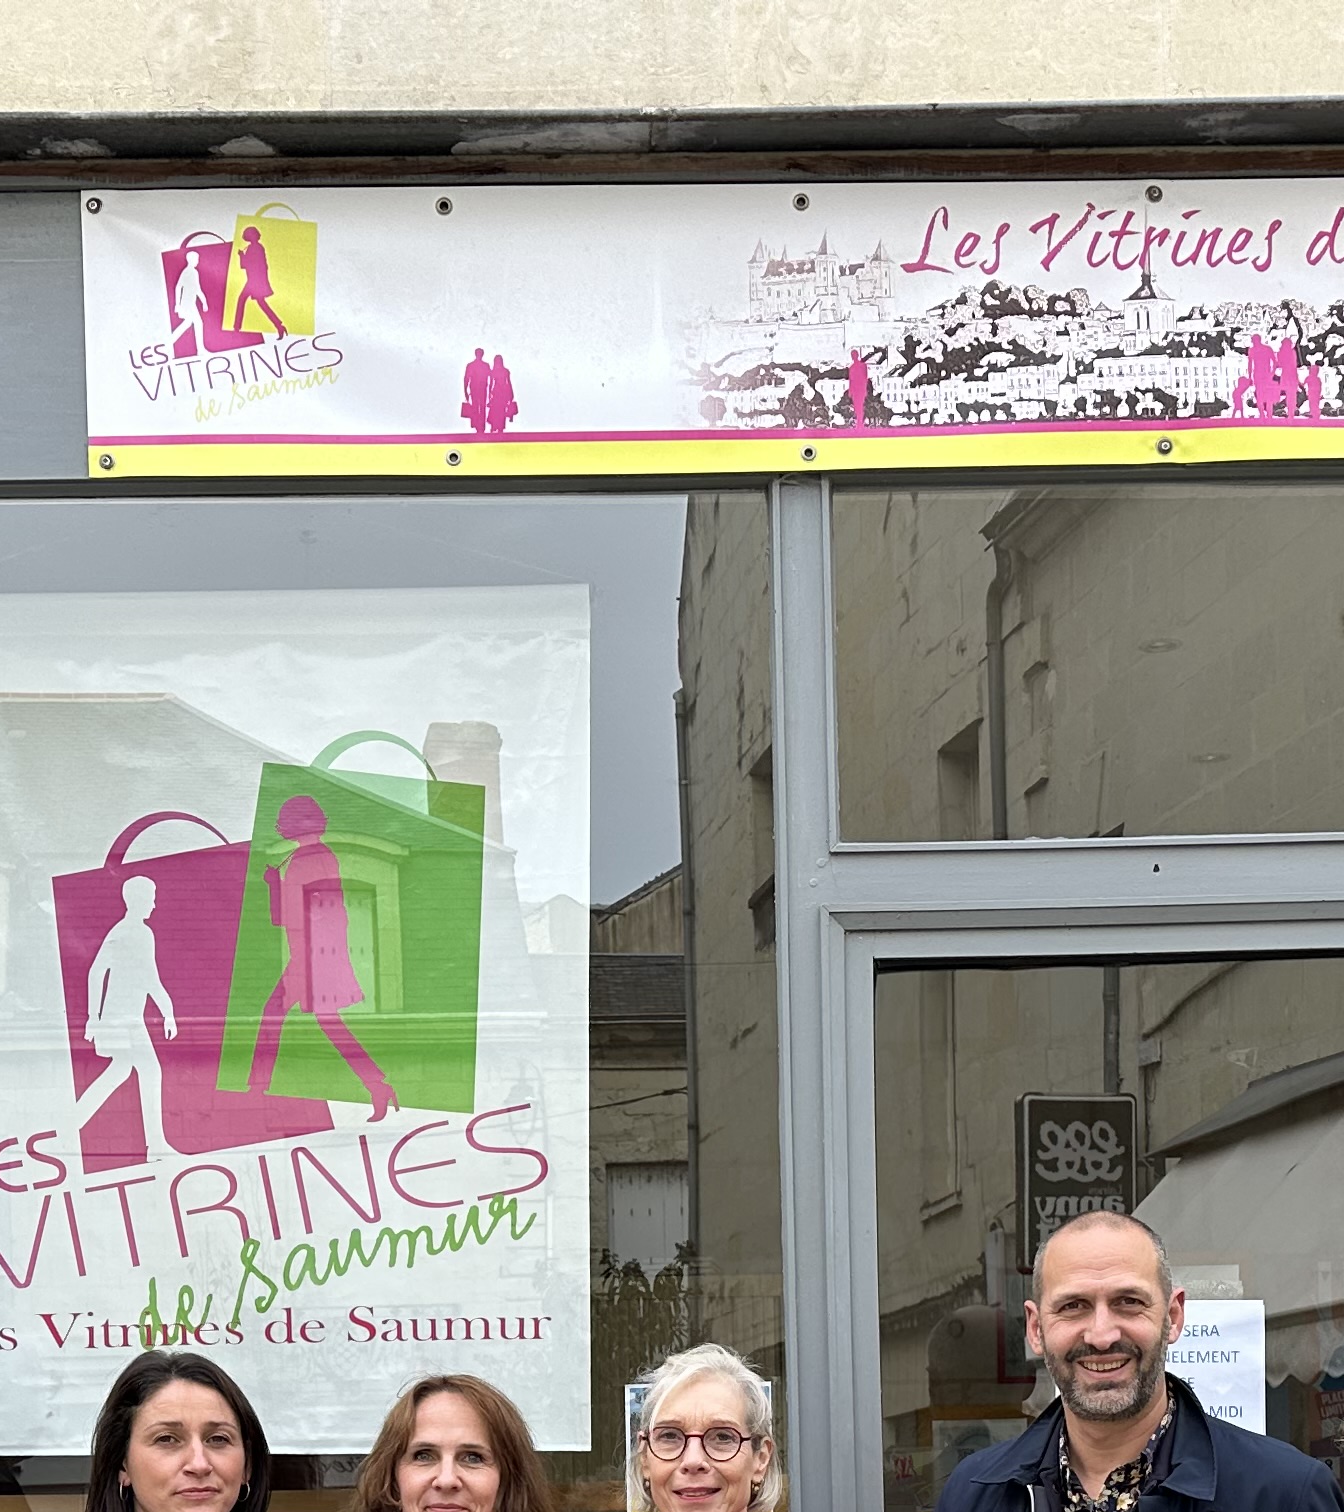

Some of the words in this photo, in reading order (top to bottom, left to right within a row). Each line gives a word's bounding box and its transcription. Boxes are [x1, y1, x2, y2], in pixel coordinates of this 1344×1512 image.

[901, 205, 1012, 276] Les
[1029, 202, 1283, 272] Vitrines
[128, 344, 169, 369] LES
[132, 332, 344, 401] VITRINES
[194, 395, 223, 424] de
[36, 1311, 245, 1350] Vitrines
[264, 1308, 327, 1345] de
[346, 1304, 552, 1344] Saumur
[139, 1277, 214, 1351] de
[1183, 1324, 1220, 1337] SERA
